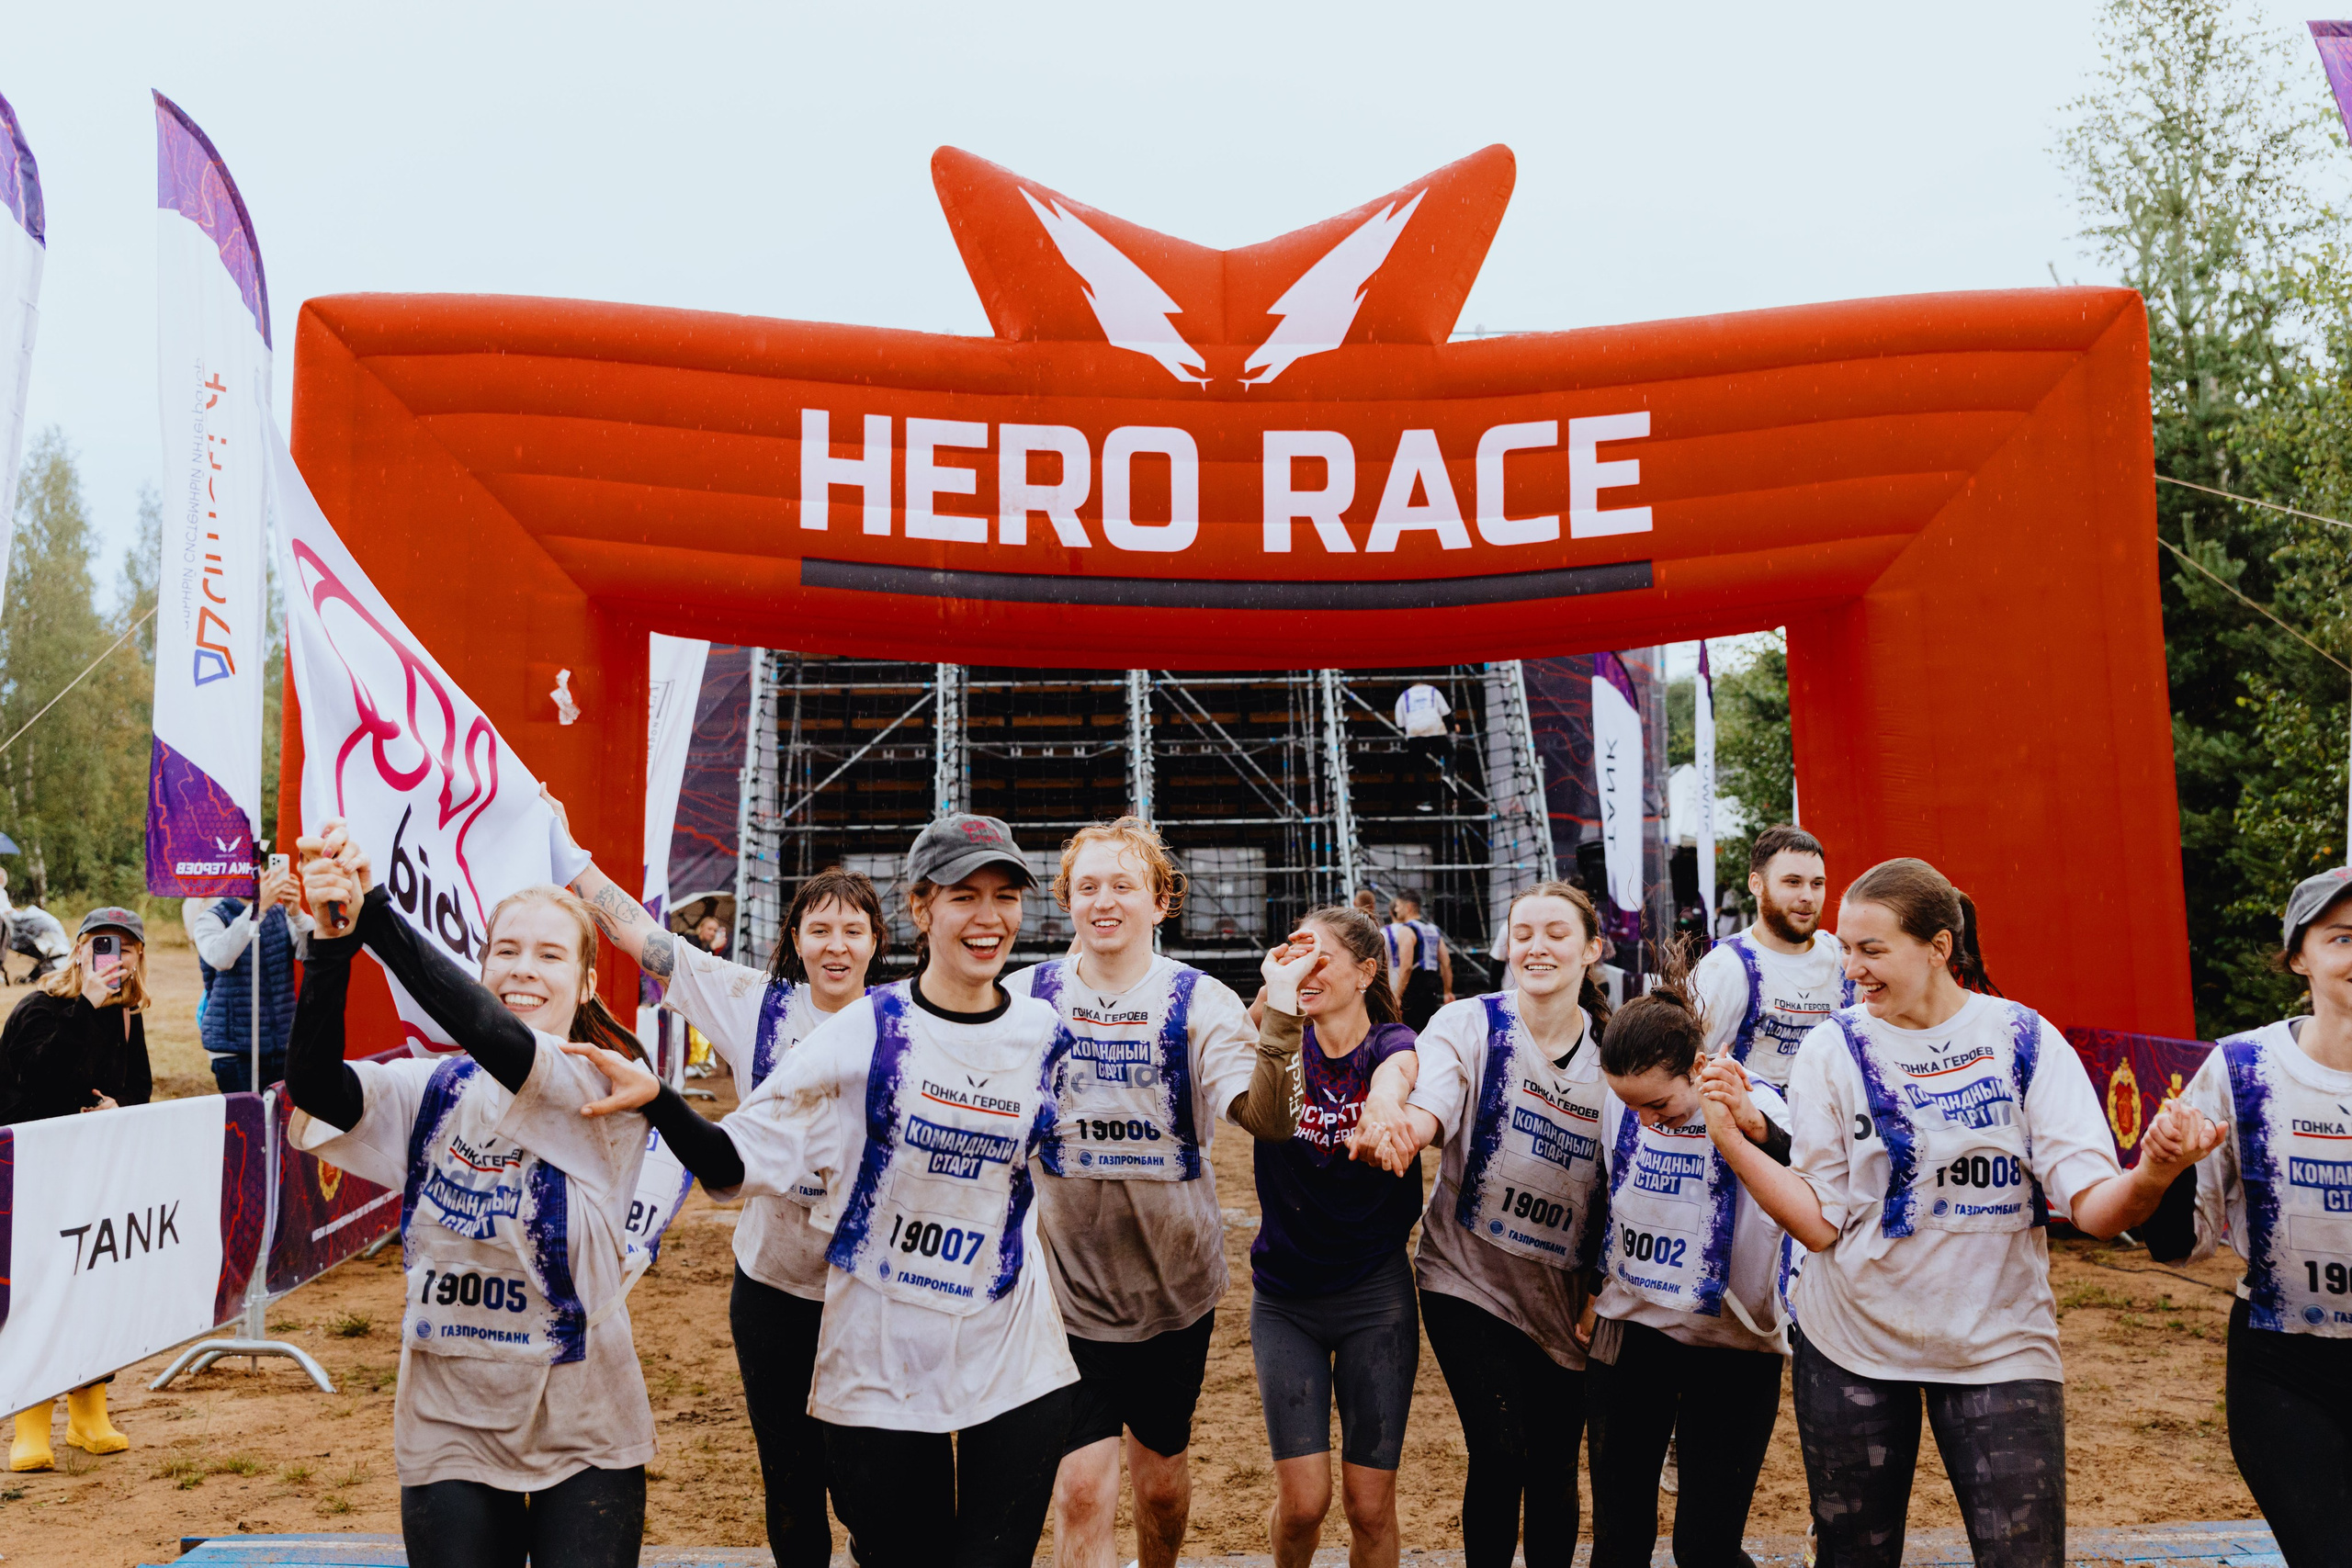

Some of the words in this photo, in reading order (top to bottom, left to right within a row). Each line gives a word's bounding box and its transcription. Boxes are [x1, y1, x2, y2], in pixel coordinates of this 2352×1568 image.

[801, 409, 1198, 551] HERO
[1263, 412, 1653, 553] RACE
[1104, 1011, 1148, 1022] ГЕРОЕВ
[1775, 998, 1802, 1010] ГОНКА
[1943, 1046, 1995, 1068] ГЕРОЕВ
[922, 1079, 967, 1104] ГОНКА
[973, 1094, 1022, 1113] ГЕРОЕВ
[1285, 1051, 1305, 1117] Fitch
[1523, 1078, 1555, 1104] ГОНКА
[1557, 1098, 1600, 1120] ГЕРОЕВ
[907, 1121, 1015, 1163] КОМАНДНЫЙ
[1076, 1119, 1161, 1141] 19006
[1515, 1111, 1596, 1157] КОМАНДНЫЙ
[2292, 1119, 2346, 1134] ГОНКА
[932, 1154, 980, 1178] СТАРТ
[1099, 1155, 1165, 1167] ГАЗПРОМБАНК
[1535, 1138, 1570, 1167] СТАРТ
[1635, 1169, 1679, 1192] СТАРТ
[1937, 1155, 2021, 1189] 19008
[1501, 1187, 1574, 1232] 19001
[60, 1200, 179, 1276] TANK
[889, 1213, 986, 1266] 19007
[1508, 1230, 1566, 1257] ГАЗПРОМБАНК
[1621, 1223, 1687, 1268] 19002
[421, 1269, 527, 1314] 19005
[898, 1271, 974, 1298] ГАЗПРОМБАНК
[441, 1325, 530, 1345] ГАЗПРОМБАНК
